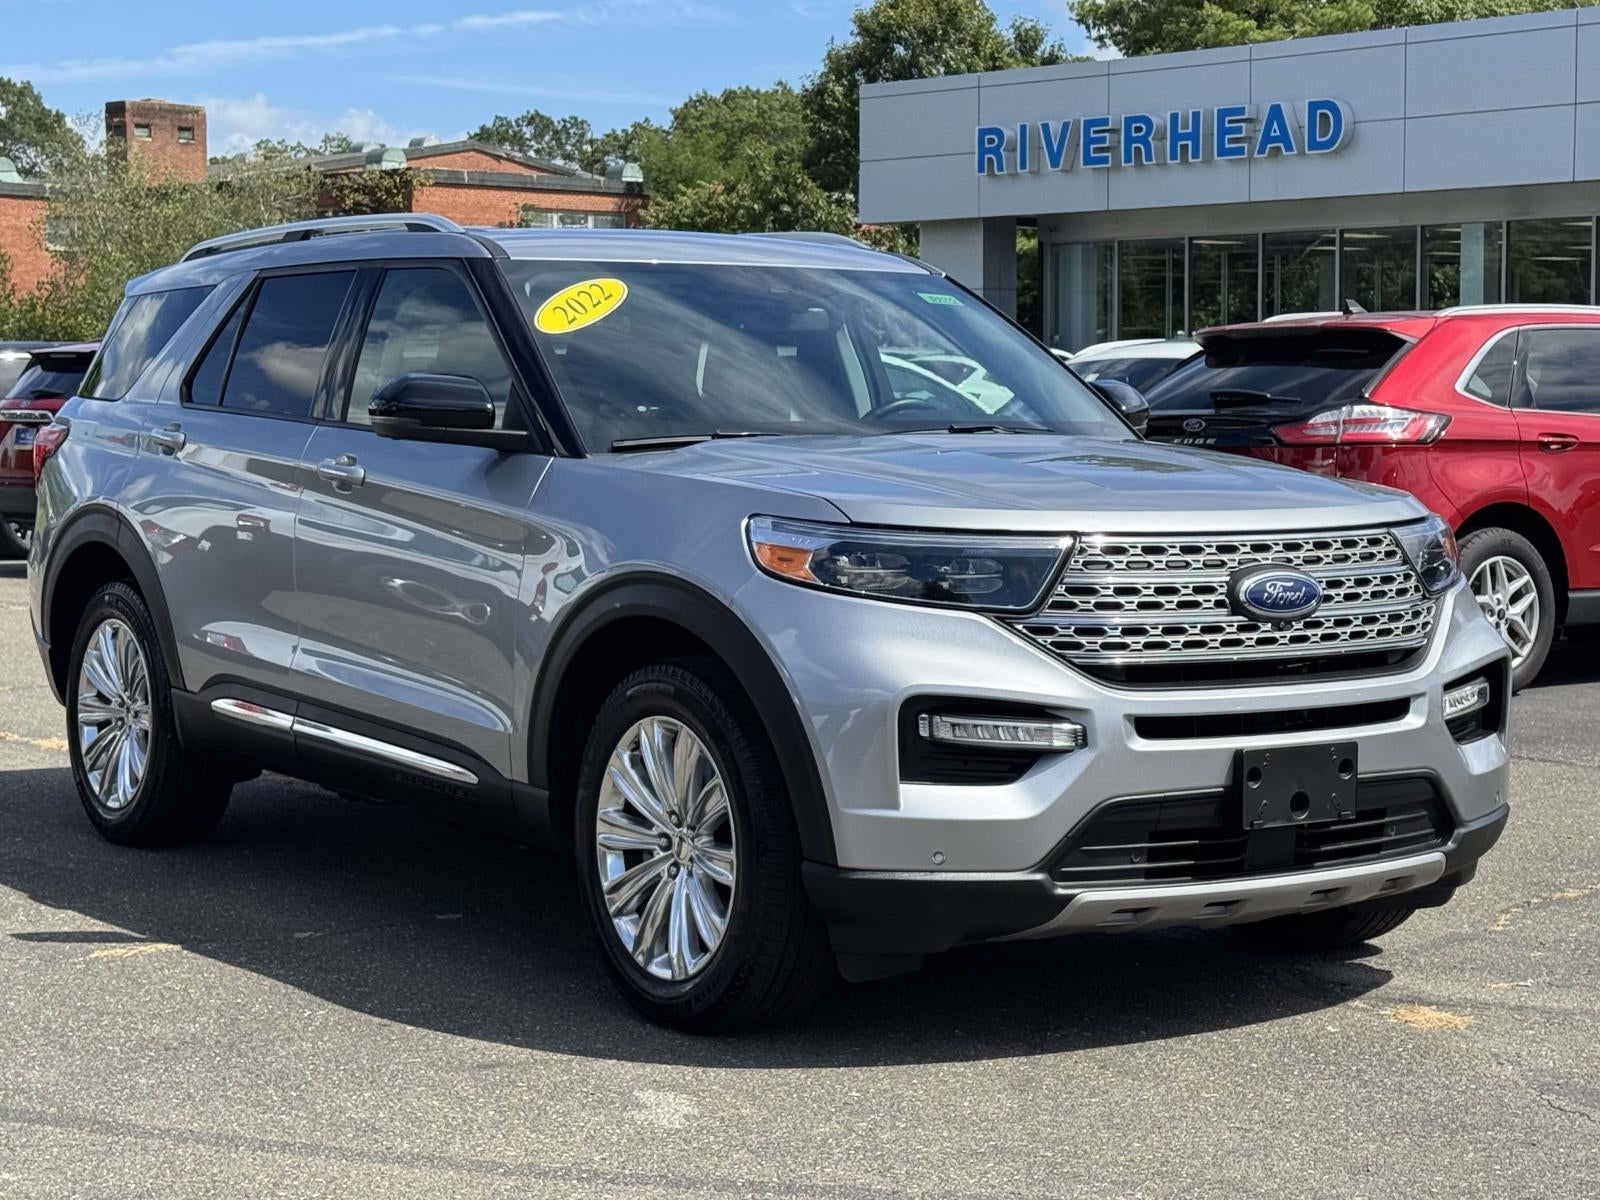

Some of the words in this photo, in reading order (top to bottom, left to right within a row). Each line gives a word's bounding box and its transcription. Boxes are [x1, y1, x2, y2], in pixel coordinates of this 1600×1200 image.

[976, 98, 1346, 176] RIVERHEAD
[553, 283, 613, 325] 2022
[1263, 581, 1306, 606] Ford
